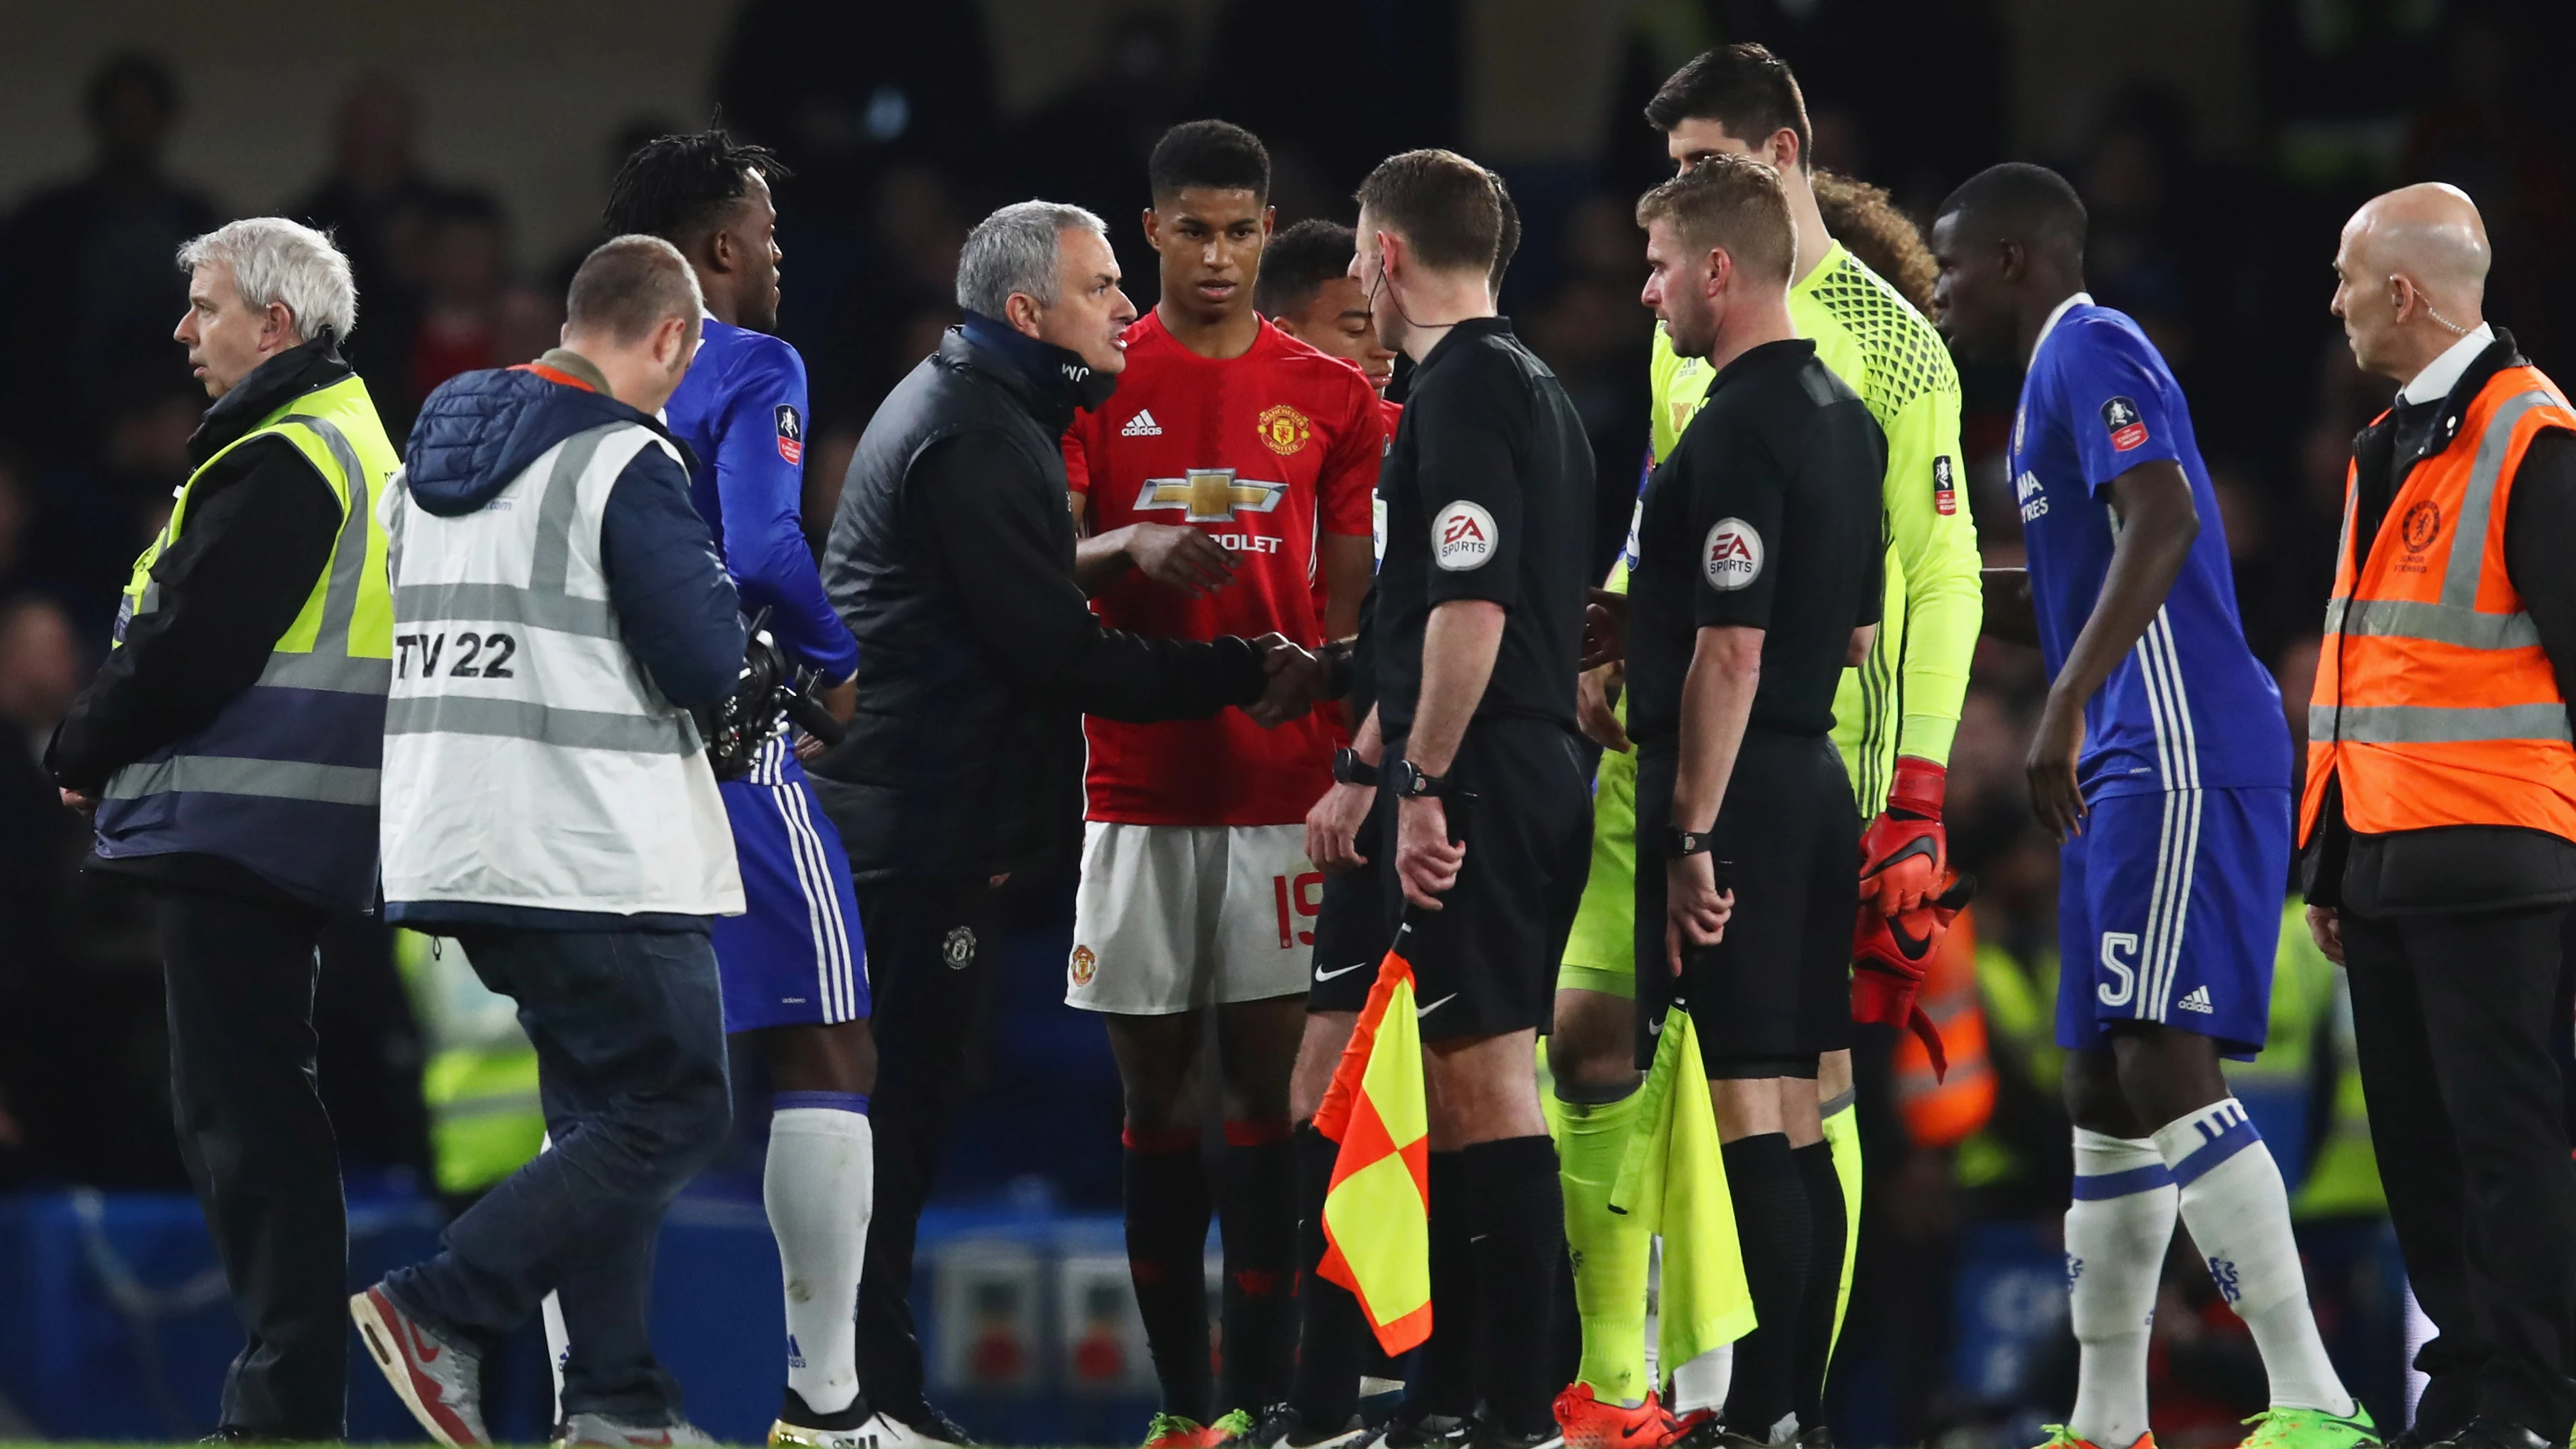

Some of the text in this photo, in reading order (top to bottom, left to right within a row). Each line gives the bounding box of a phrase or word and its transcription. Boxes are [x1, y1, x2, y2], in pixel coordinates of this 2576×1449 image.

[1121, 426, 1162, 436] adidas
[1443, 515, 1486, 546] EA
[1441, 541, 1486, 557] SPORTS
[1711, 533, 1752, 561] EA
[1710, 559, 1752, 574] SPORTS
[396, 632, 516, 679] TV 22
[2098, 931, 2138, 1007] 5
[2177, 1000, 2214, 1014] adidas
